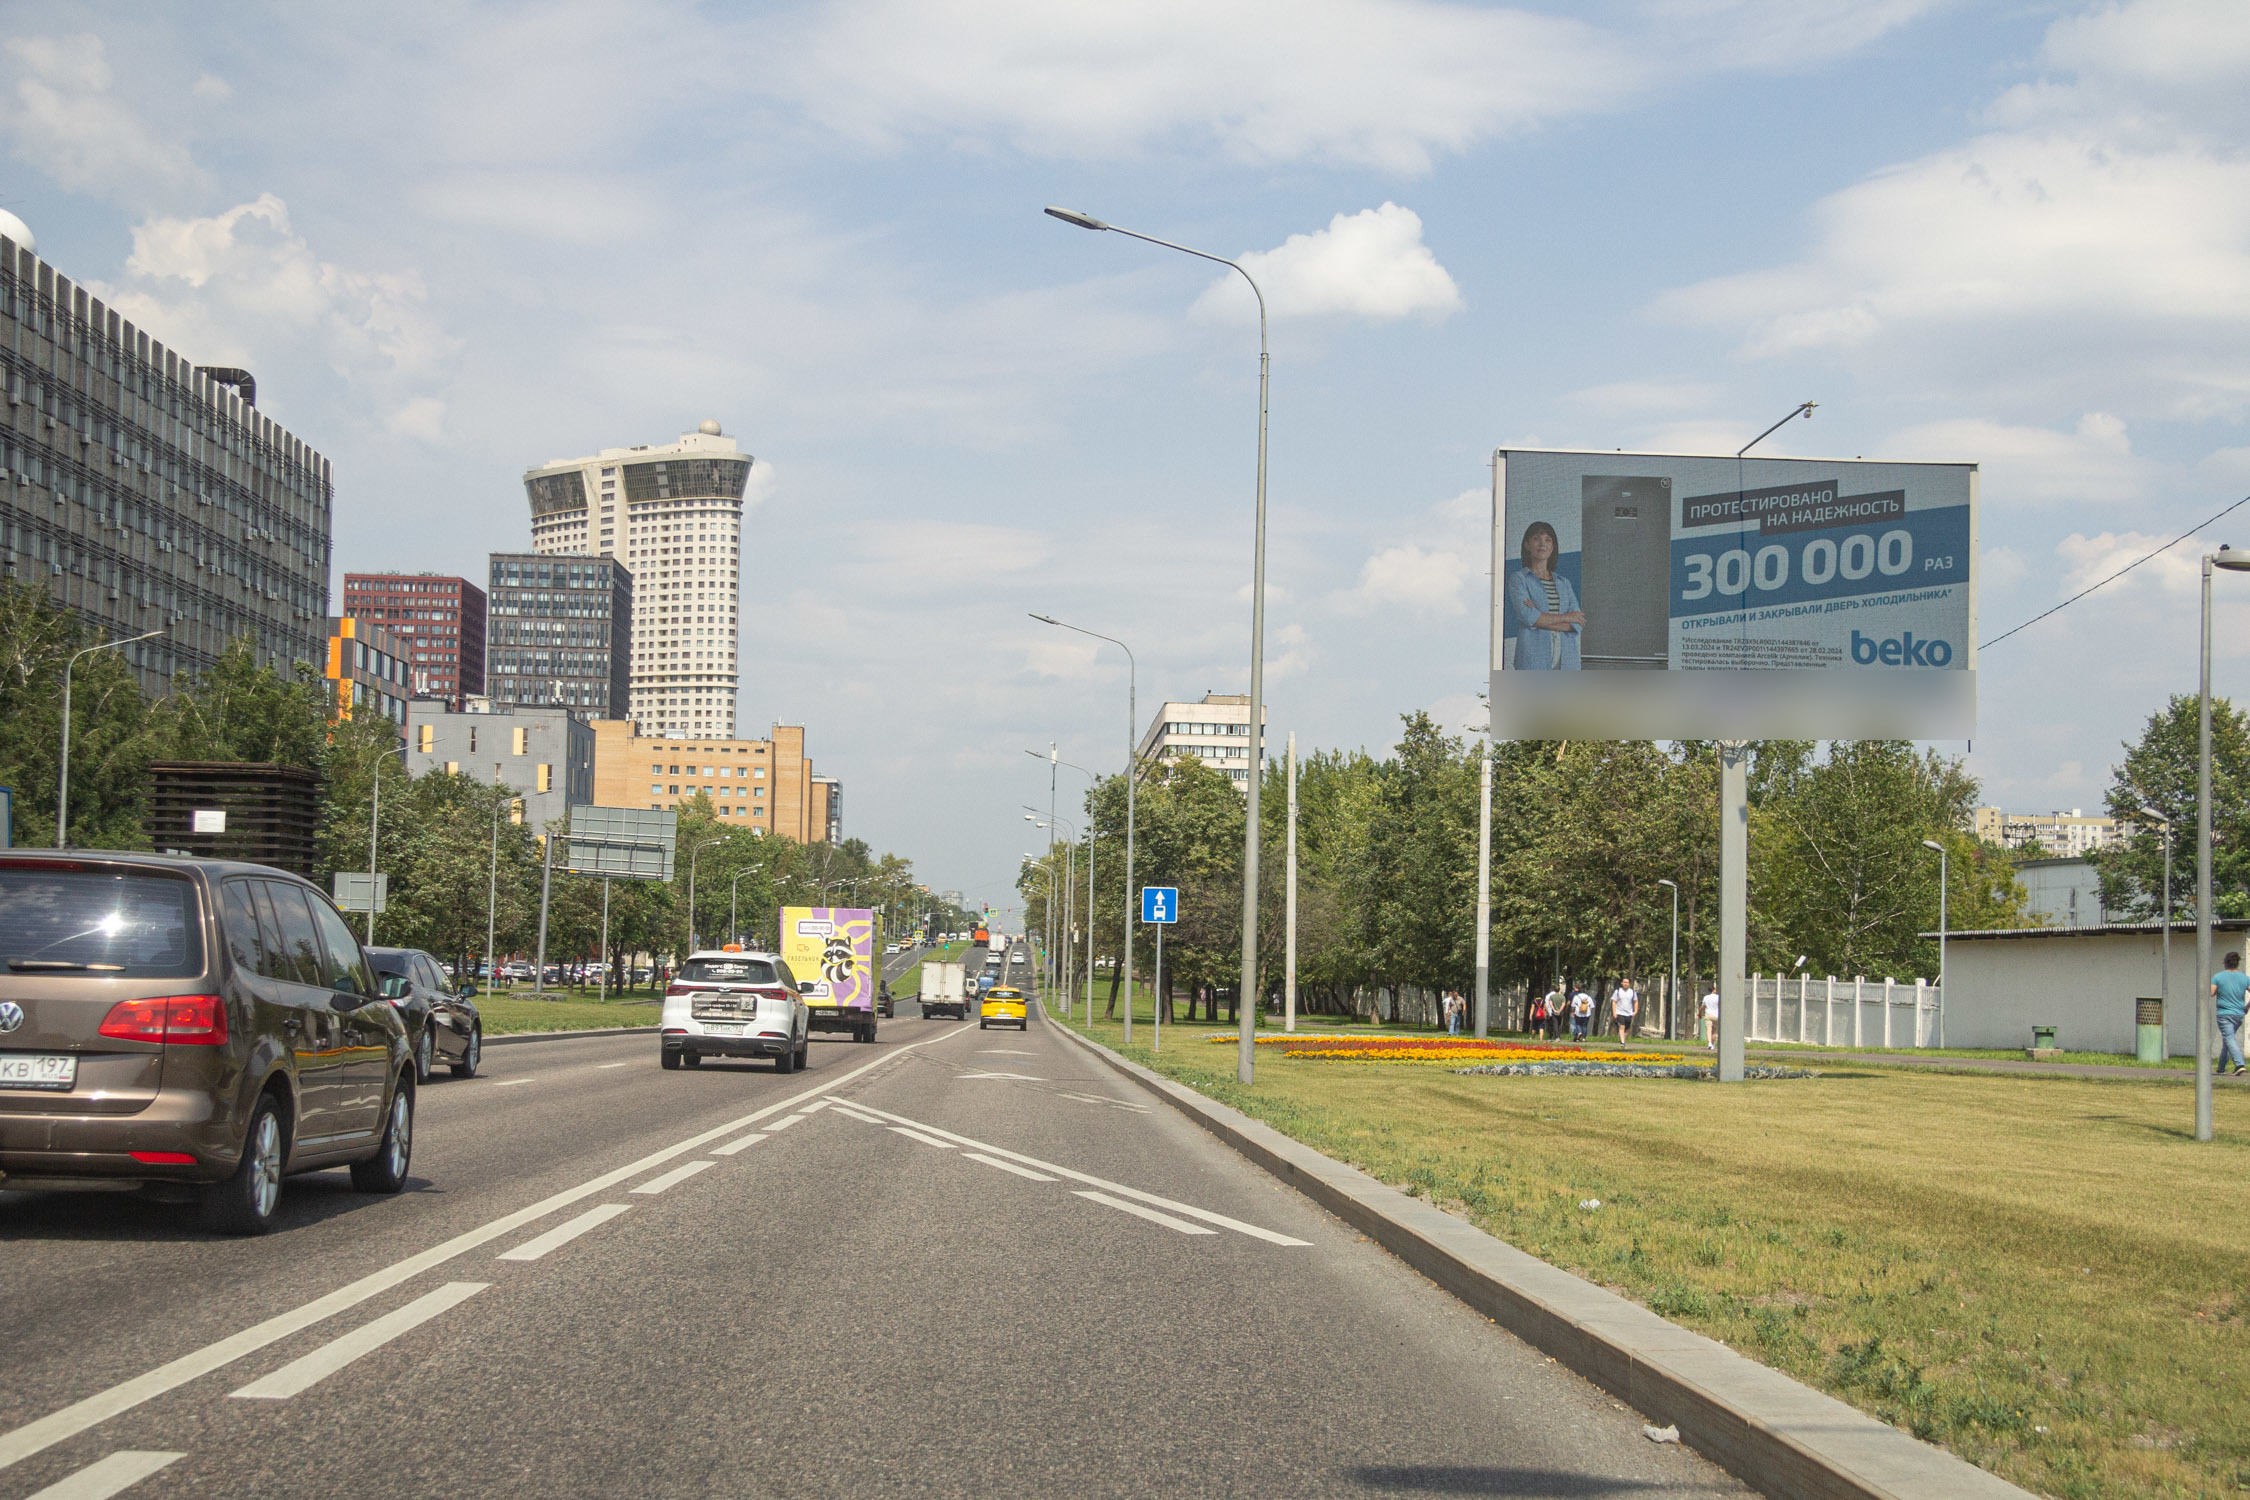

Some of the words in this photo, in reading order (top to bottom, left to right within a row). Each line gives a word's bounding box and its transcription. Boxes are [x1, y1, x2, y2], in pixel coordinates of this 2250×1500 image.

[1690, 489, 1833, 519] ПРОТЕСТИРОВАНО
[1767, 513, 1789, 527] НА
[1791, 499, 1899, 524] НАДЕЖНОСТЬ
[1682, 544, 1789, 600] 300
[1802, 529, 1913, 585] 000
[1924, 556, 1953, 572] РАЗ
[1682, 613, 1746, 630] ОТКРЫВАЛИ
[1749, 611, 1756, 621] И
[1758, 603, 1823, 621] ЗАКРЫВАЛИ
[1824, 599, 1859, 614] ДВЕРЬ
[1851, 630, 1952, 667] beko
[37, 1057, 69, 1073] 197
